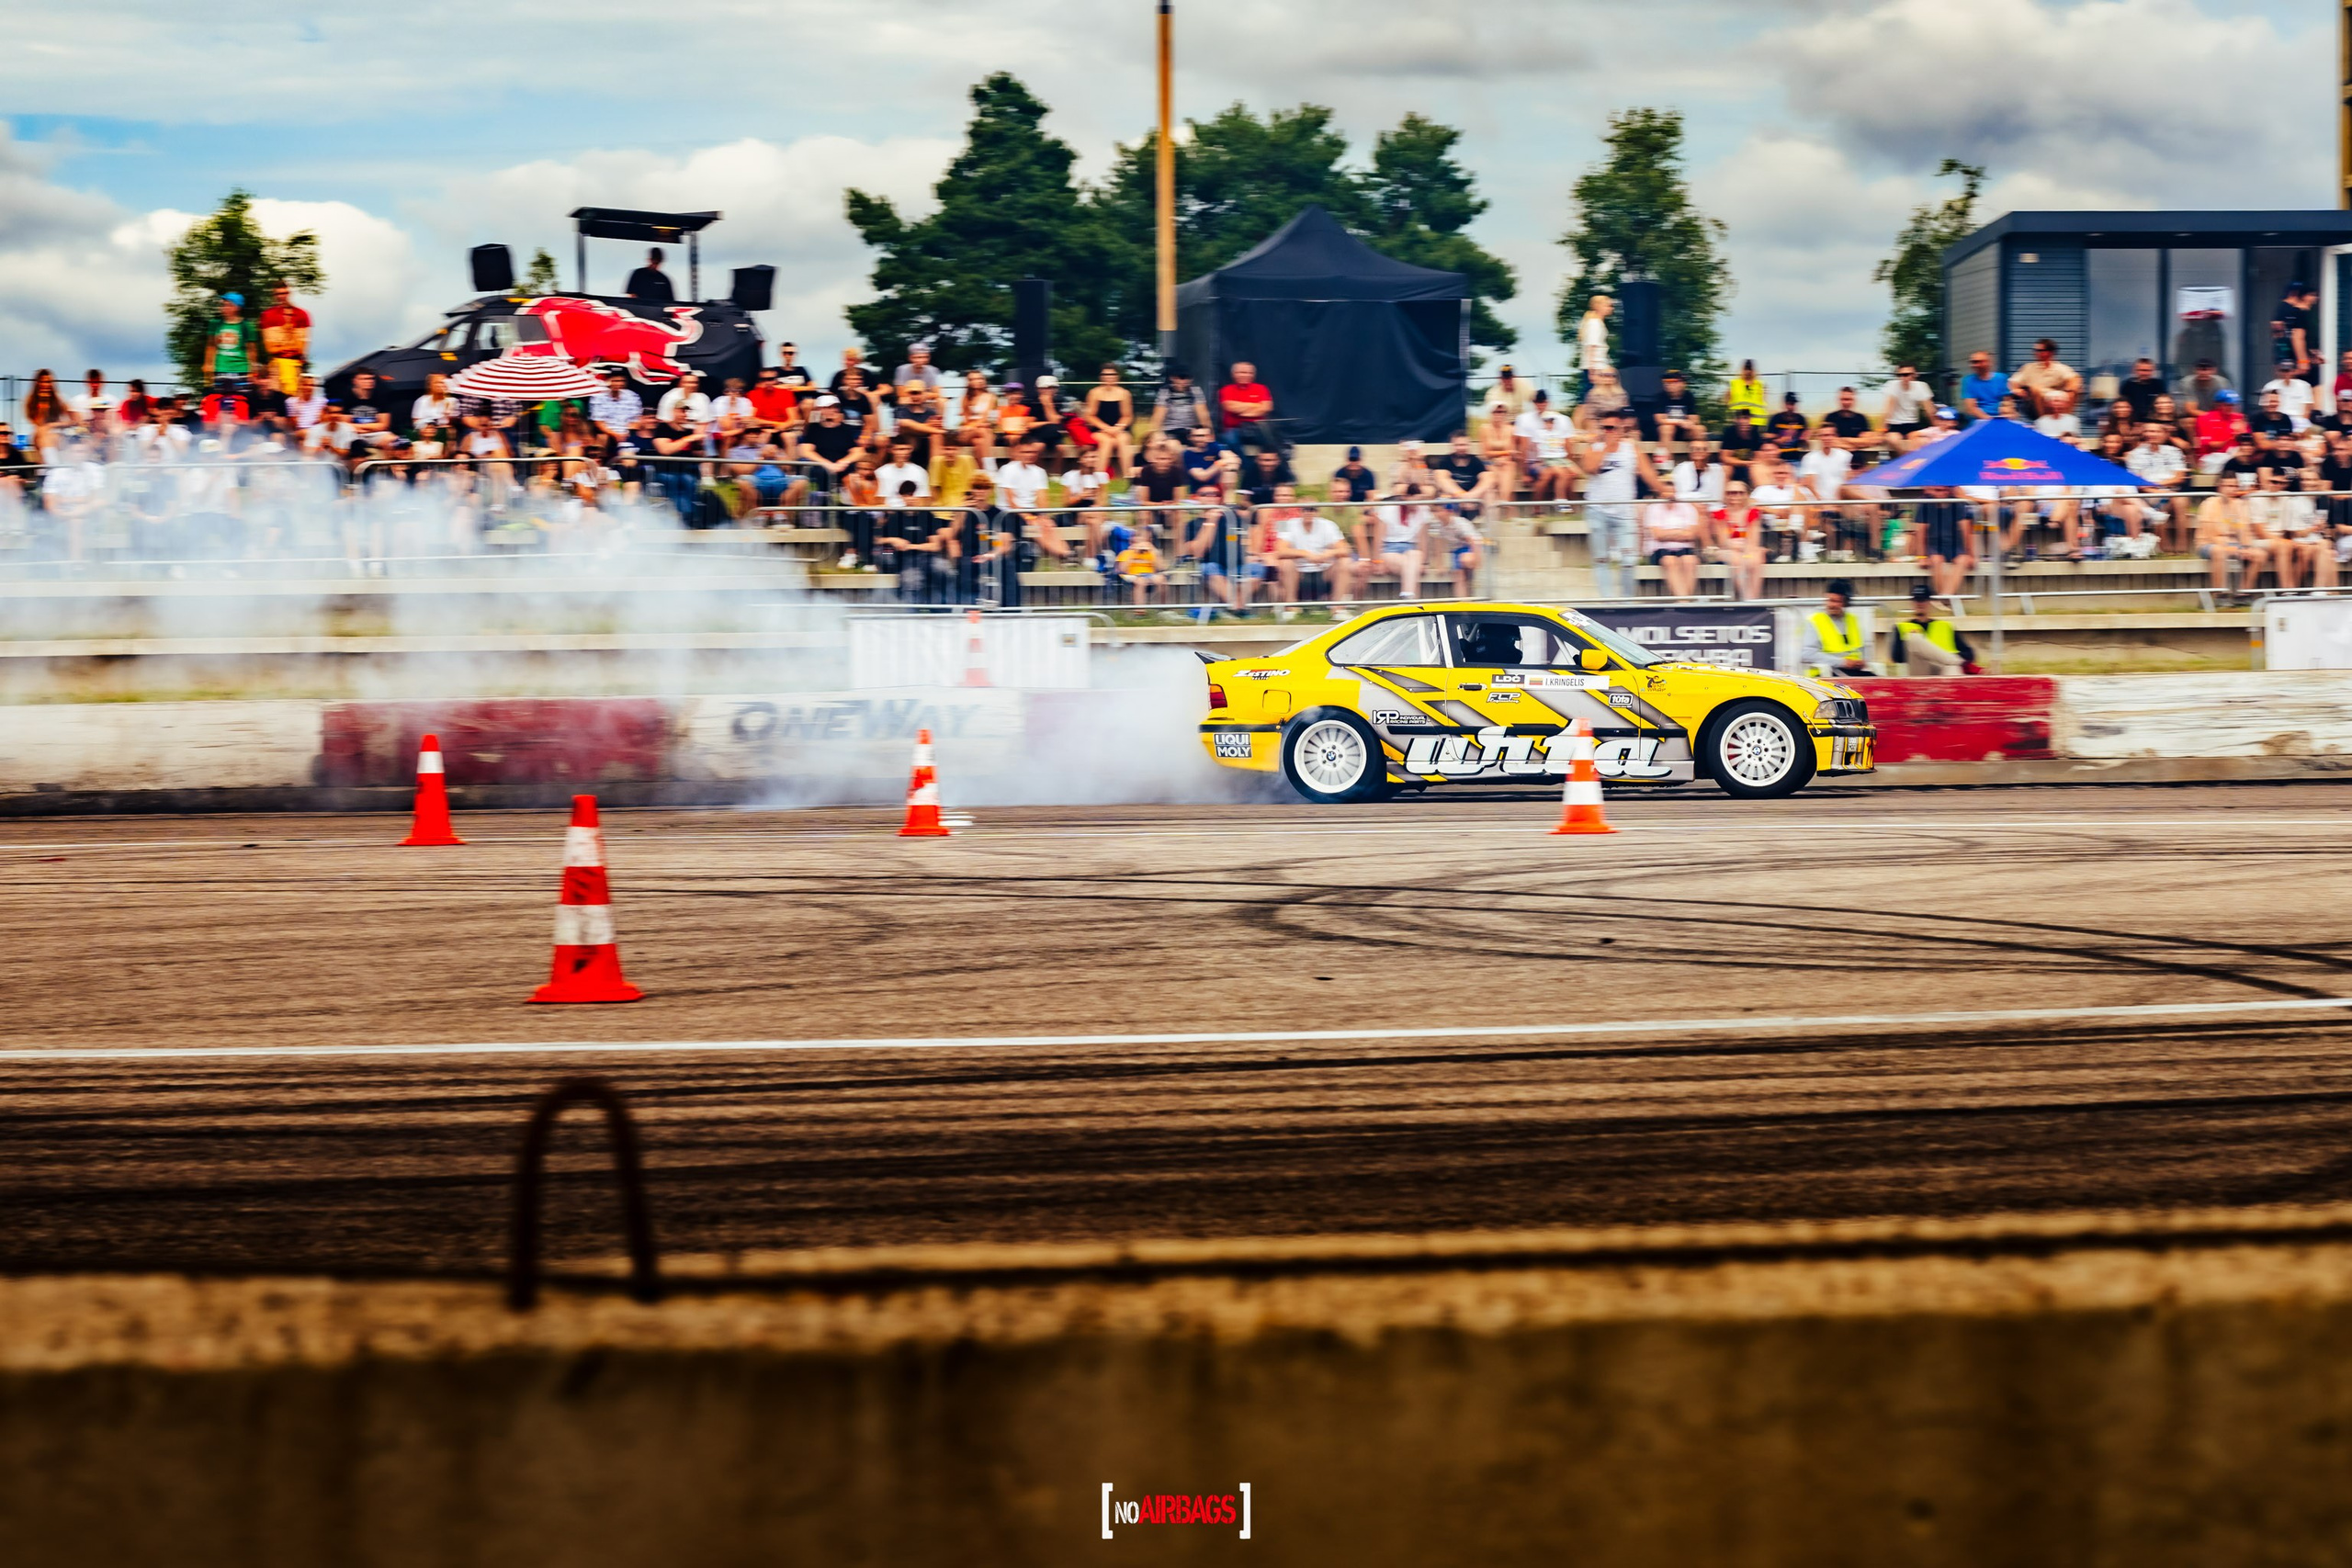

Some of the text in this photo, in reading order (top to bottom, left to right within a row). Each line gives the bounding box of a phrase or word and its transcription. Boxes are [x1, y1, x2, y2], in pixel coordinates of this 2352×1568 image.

[1232, 669, 1291, 677] ZESTINO
[1544, 678, 1585, 687] I.KRINGELIS
[1215, 734, 1250, 746] LIQUI
[1217, 747, 1251, 758] MOLY
